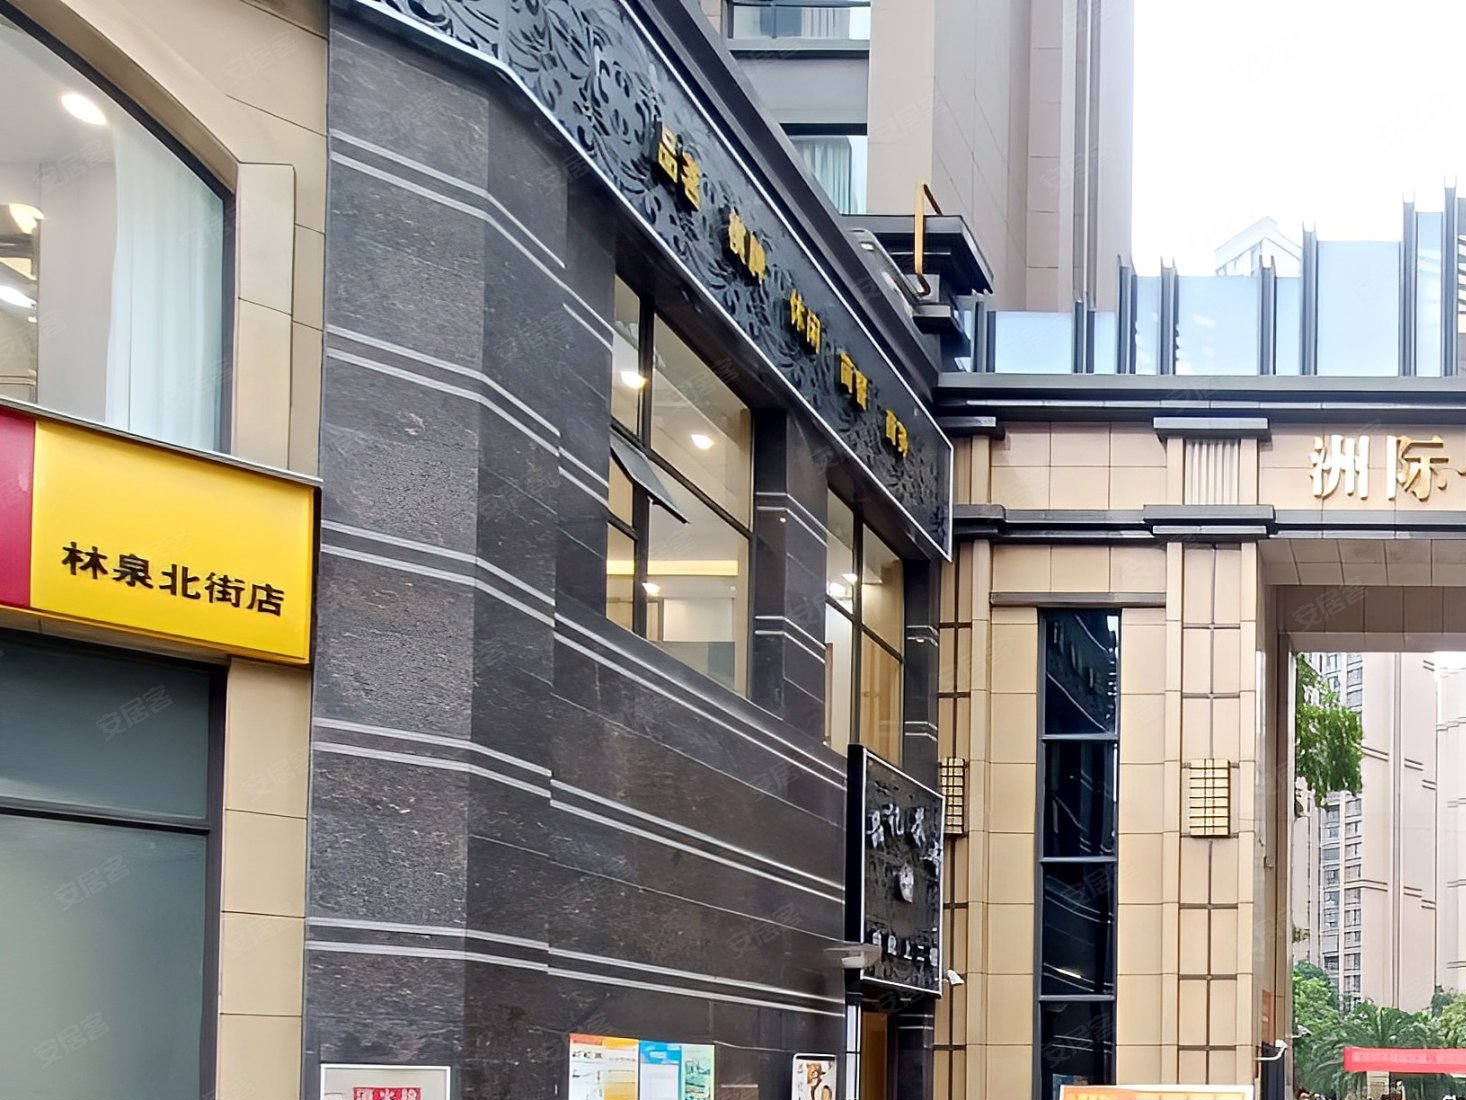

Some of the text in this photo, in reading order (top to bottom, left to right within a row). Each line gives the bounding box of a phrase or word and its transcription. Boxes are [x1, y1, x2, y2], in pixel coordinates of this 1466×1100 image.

[62, 541, 285, 617] 林泉北街店
